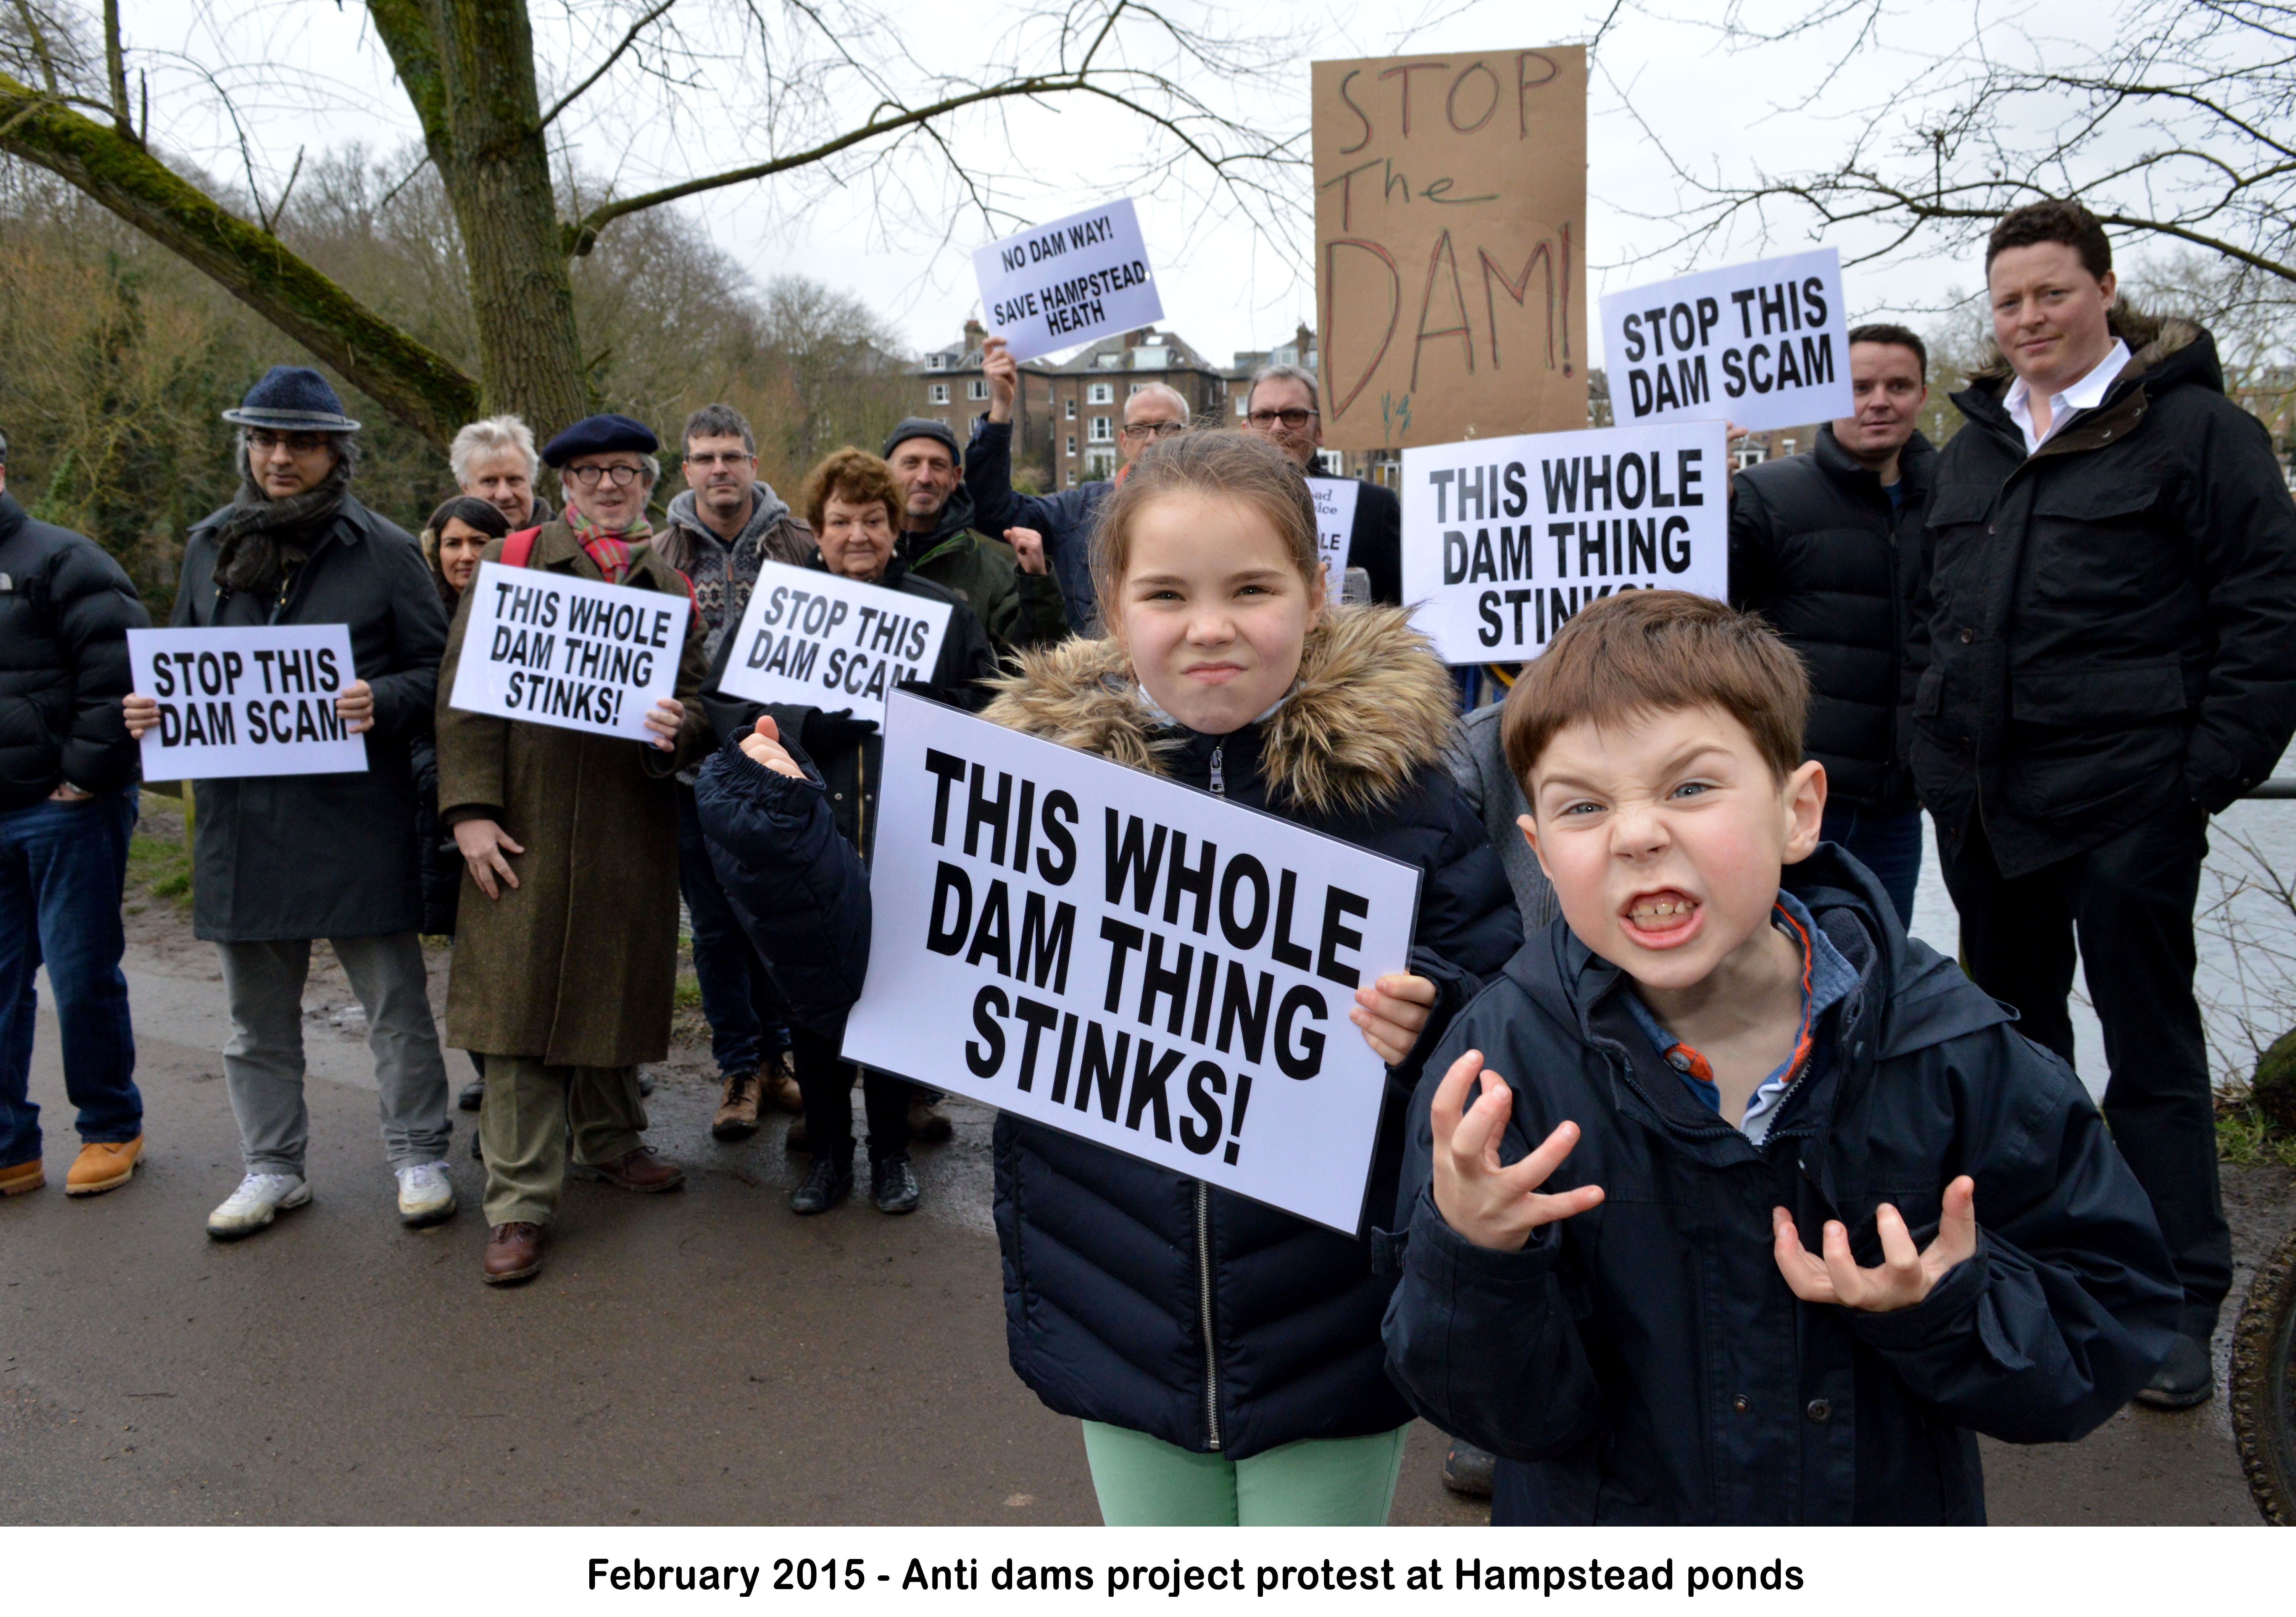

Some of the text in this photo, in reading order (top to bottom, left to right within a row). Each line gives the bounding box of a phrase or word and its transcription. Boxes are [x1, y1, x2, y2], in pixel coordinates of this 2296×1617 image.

[1340, 52, 1561, 154] STOP
[1319, 158, 1499, 232] The
[1001, 216, 1113, 272] NO DAM WAY!
[995, 260, 1145, 326] SAVE HAMPSTEAD
[1046, 299, 1105, 336] HEATH
[1324, 222, 1574, 422] DAM!
[1623, 277, 1827, 363] STOP THIS
[1628, 334, 1834, 417] DAM SCAM
[1315, 503, 1338, 514] ice
[1430, 449, 1703, 523] THIS WHOLE
[1444, 515, 1690, 585] DAM THING
[495, 582, 672, 648] THIS WHOLE
[764, 587, 929, 661] STOP THIS
[1478, 583, 1654, 647] STIN
[153, 648, 339, 696] STOP THIS
[490, 626, 653, 687] DAM THING
[747, 629, 820, 682] DAM
[160, 699, 347, 747] DAM SCAM
[506, 671, 623, 725] STINKS!
[925, 748, 1369, 989] THIS WHOLE
[926, 860, 1327, 1080] DAM THING
[965, 984, 1253, 1167] STINKS!
